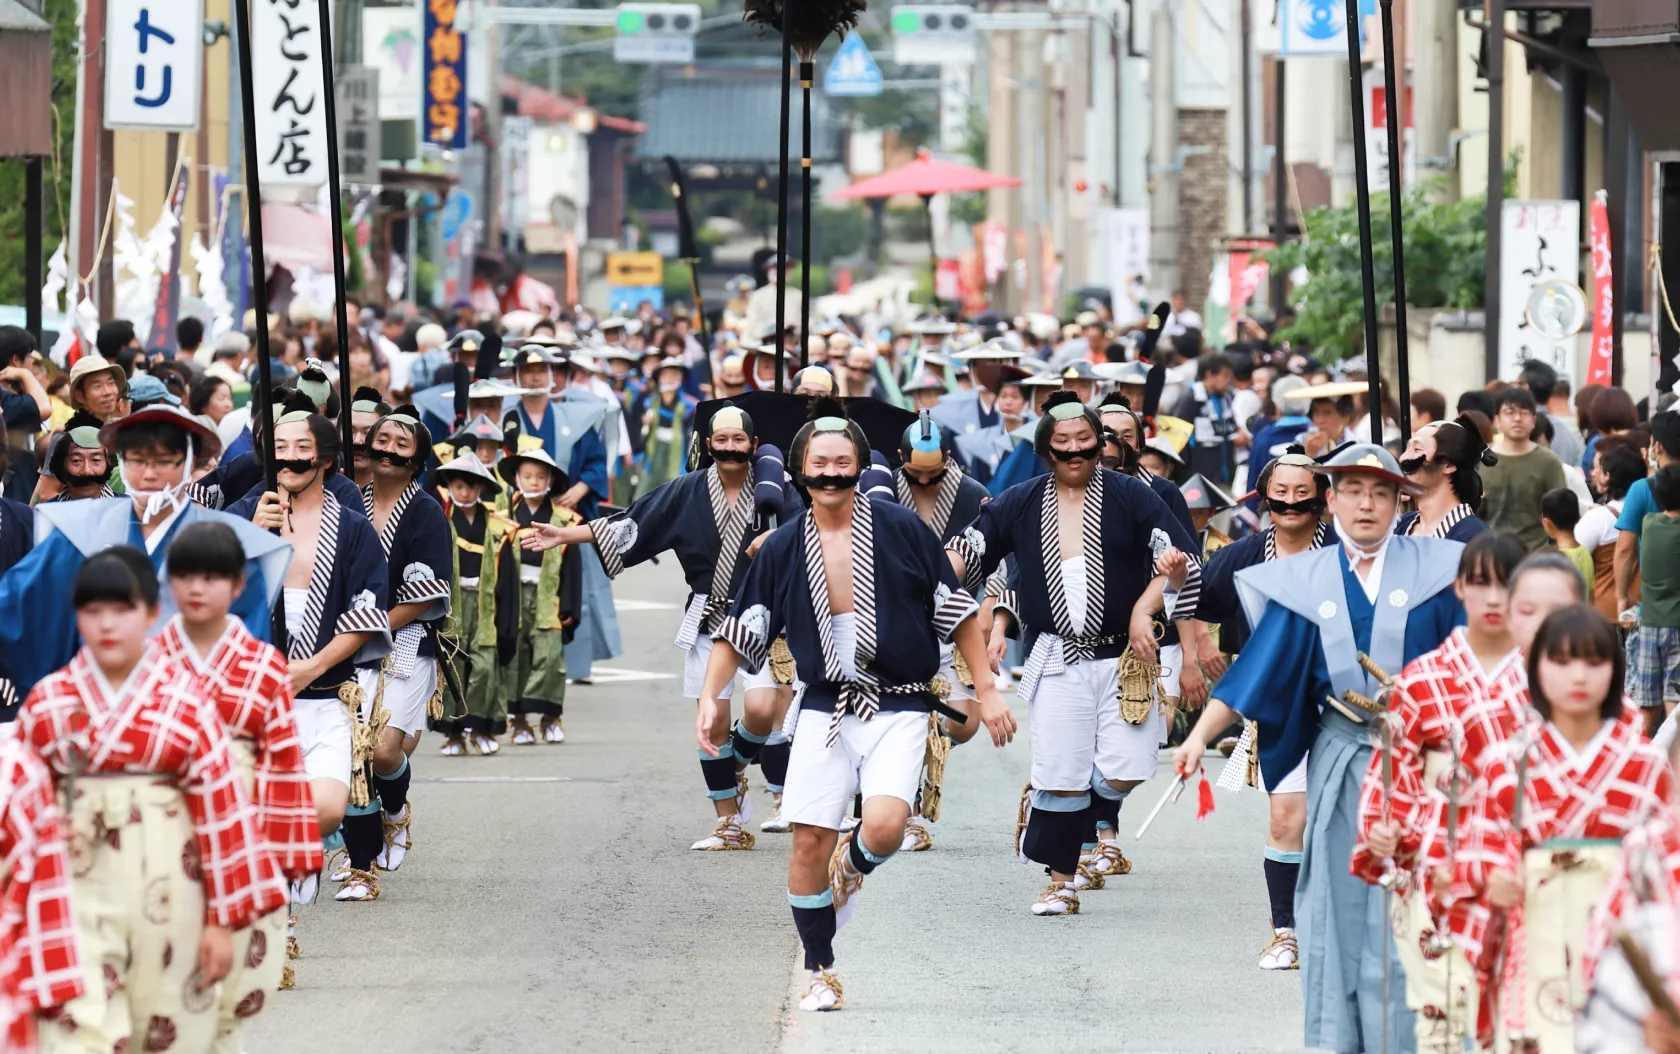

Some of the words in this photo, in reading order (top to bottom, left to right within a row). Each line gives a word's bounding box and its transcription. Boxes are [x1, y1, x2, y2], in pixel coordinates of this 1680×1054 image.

[134, 8, 175, 108] トリ
[267, 0, 316, 175] とん店
